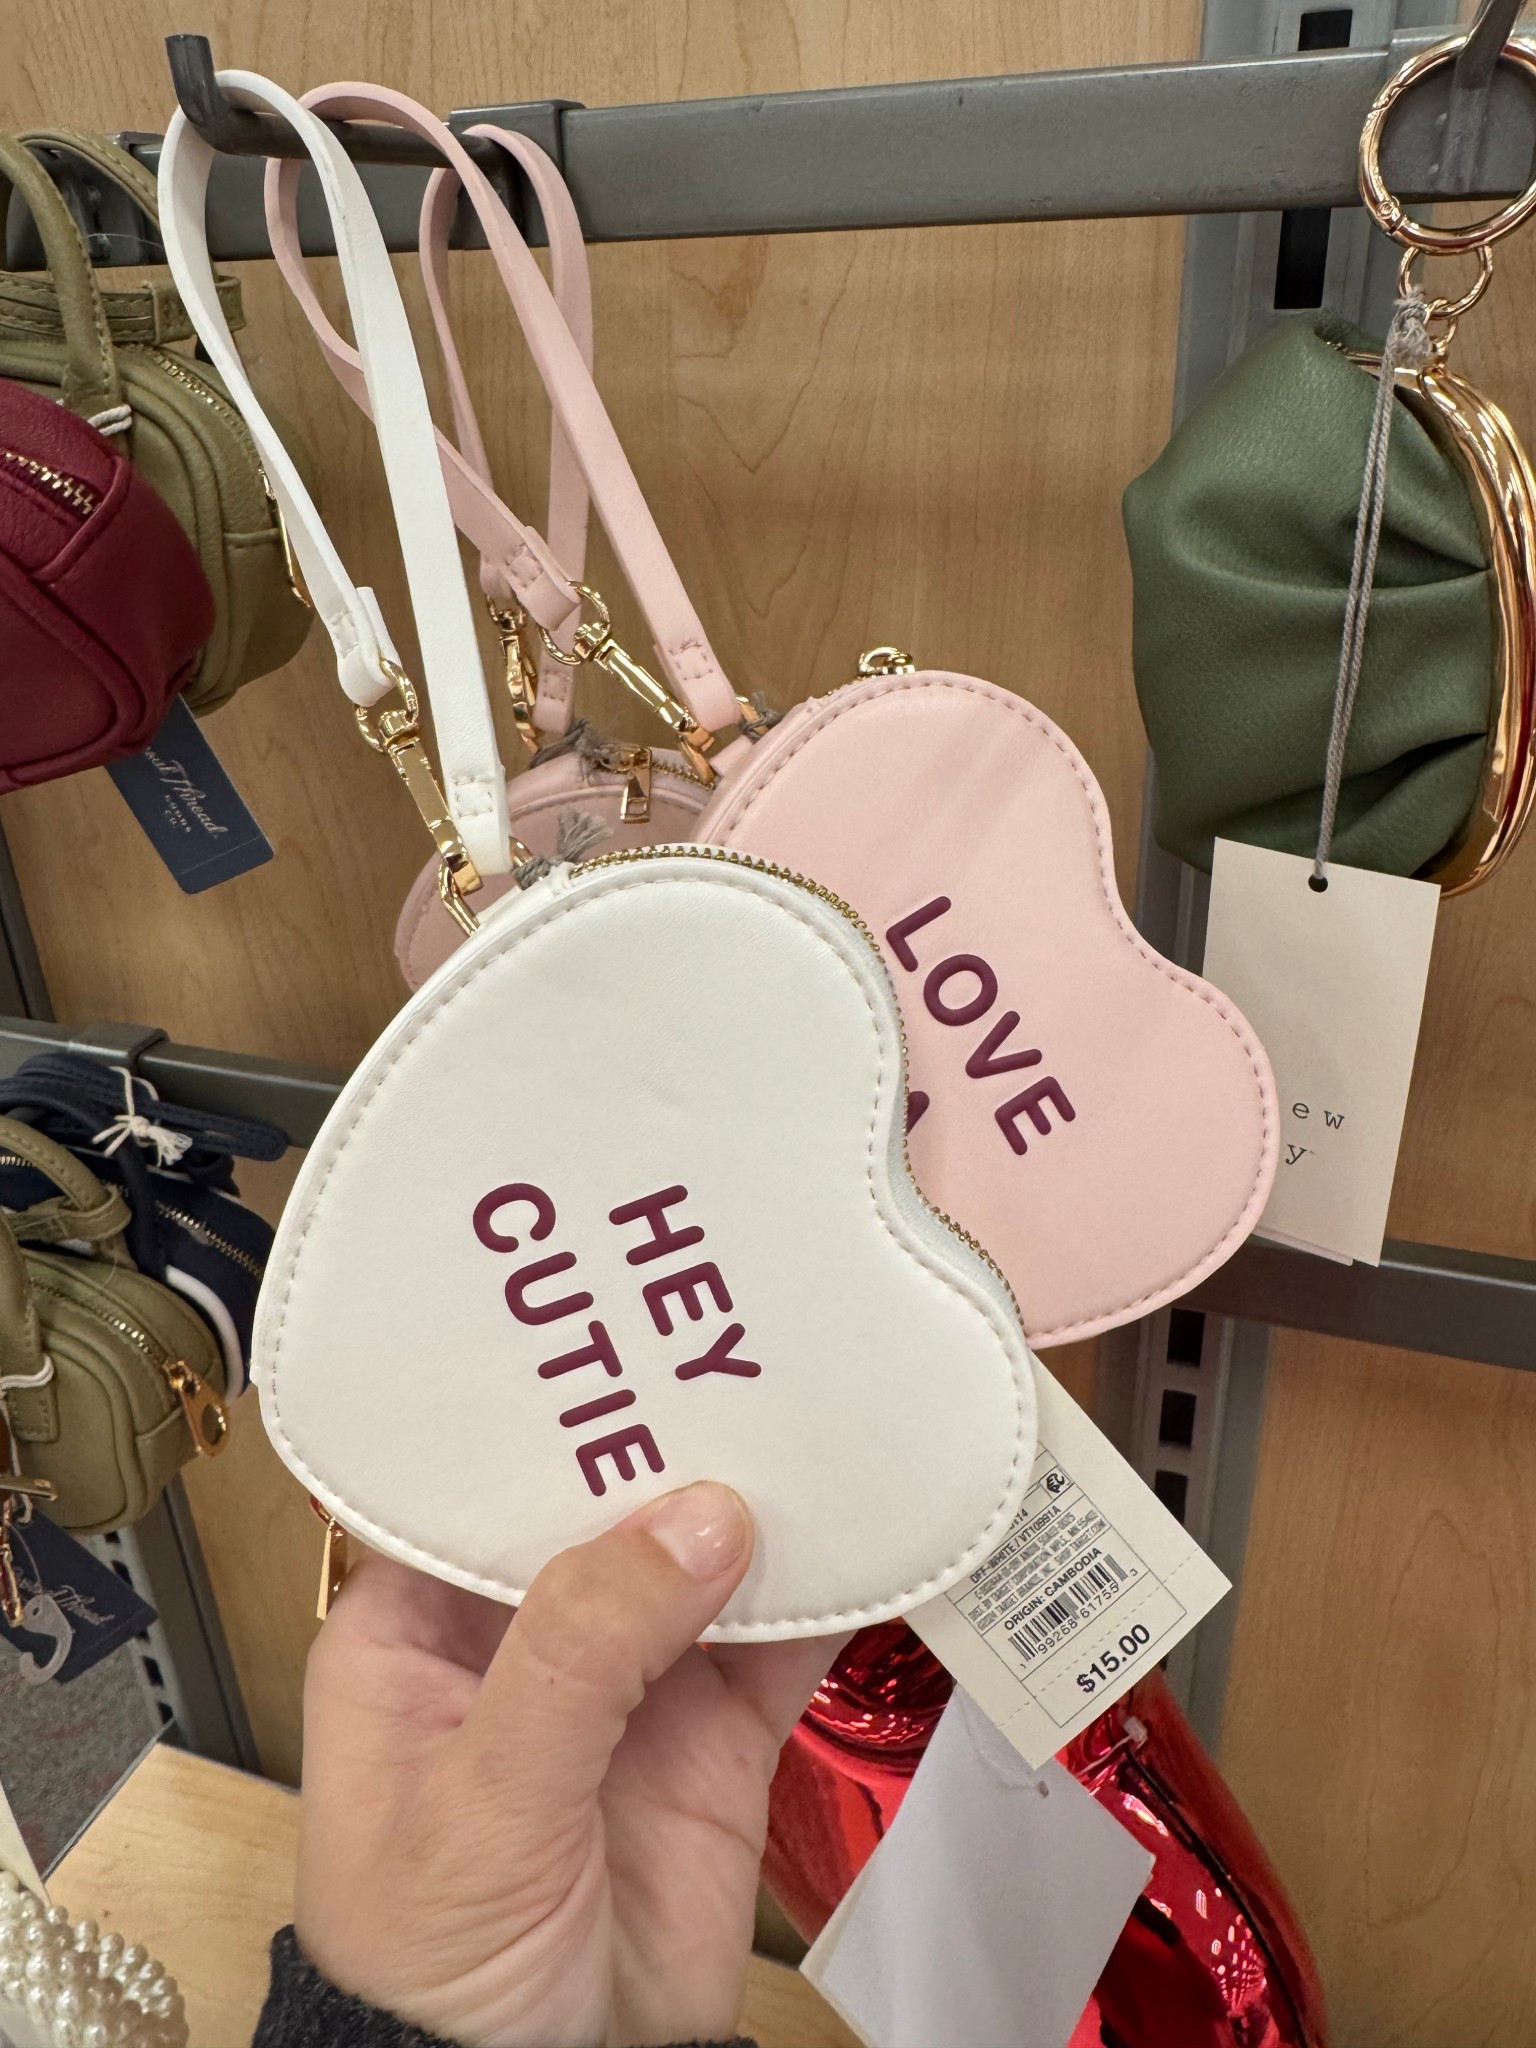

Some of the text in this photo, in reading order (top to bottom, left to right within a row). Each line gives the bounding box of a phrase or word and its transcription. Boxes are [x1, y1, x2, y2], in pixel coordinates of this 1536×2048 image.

[886, 896, 1076, 1156] LOVE
[1292, 1102, 1345, 1130] ew
[608, 1184, 762, 1381] HEY
[472, 1182, 666, 1497] CUTIE
[1003, 1594, 1046, 1631] ORIGIN:
[1043, 1547, 1102, 1597] CAMBODIA
[1037, 1616, 1079, 1655] 99268
[1079, 1580, 1120, 1619] 61755
[1076, 1623, 1152, 1694] $15.00
